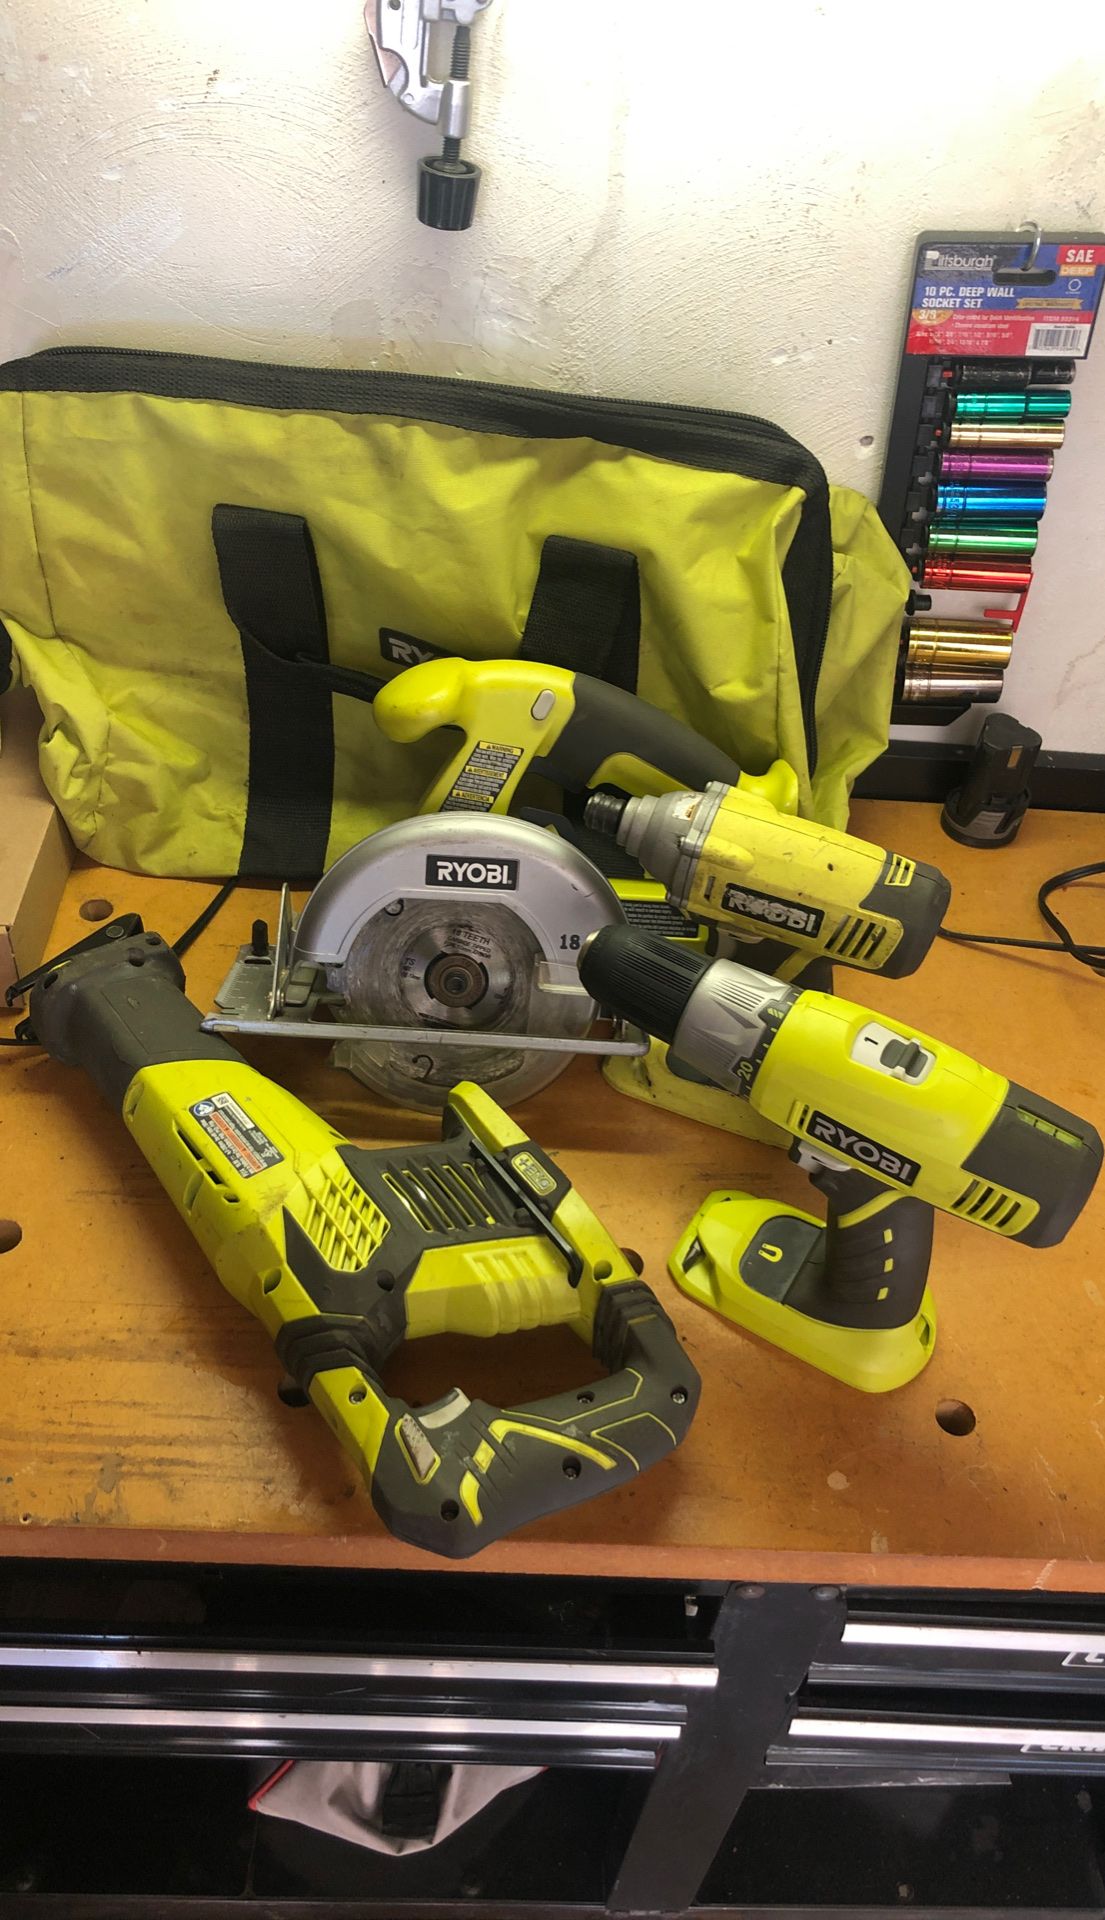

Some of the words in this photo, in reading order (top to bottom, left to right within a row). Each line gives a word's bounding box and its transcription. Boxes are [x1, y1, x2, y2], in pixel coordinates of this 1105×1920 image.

[925, 250, 994, 269] Pittsburgh
[1065, 250, 1095, 263] SAE
[924, 286, 936, 297] 10
[939, 287, 955, 297] PC.
[959, 287, 984, 297] DEEP
[986, 287, 1015, 298] WALL
[922, 298, 961, 308] SOCKET
[963, 298, 983, 308] SET
[436, 861, 509, 884] RYOBI
[727, 888, 817, 932] RYOBI
[463, 930, 491, 946] TEETH
[560, 934, 580, 950] 18
[864, 1036, 879, 1046] 1
[736, 1061, 754, 1081] 20
[814, 1117, 912, 1180] RYOBI
